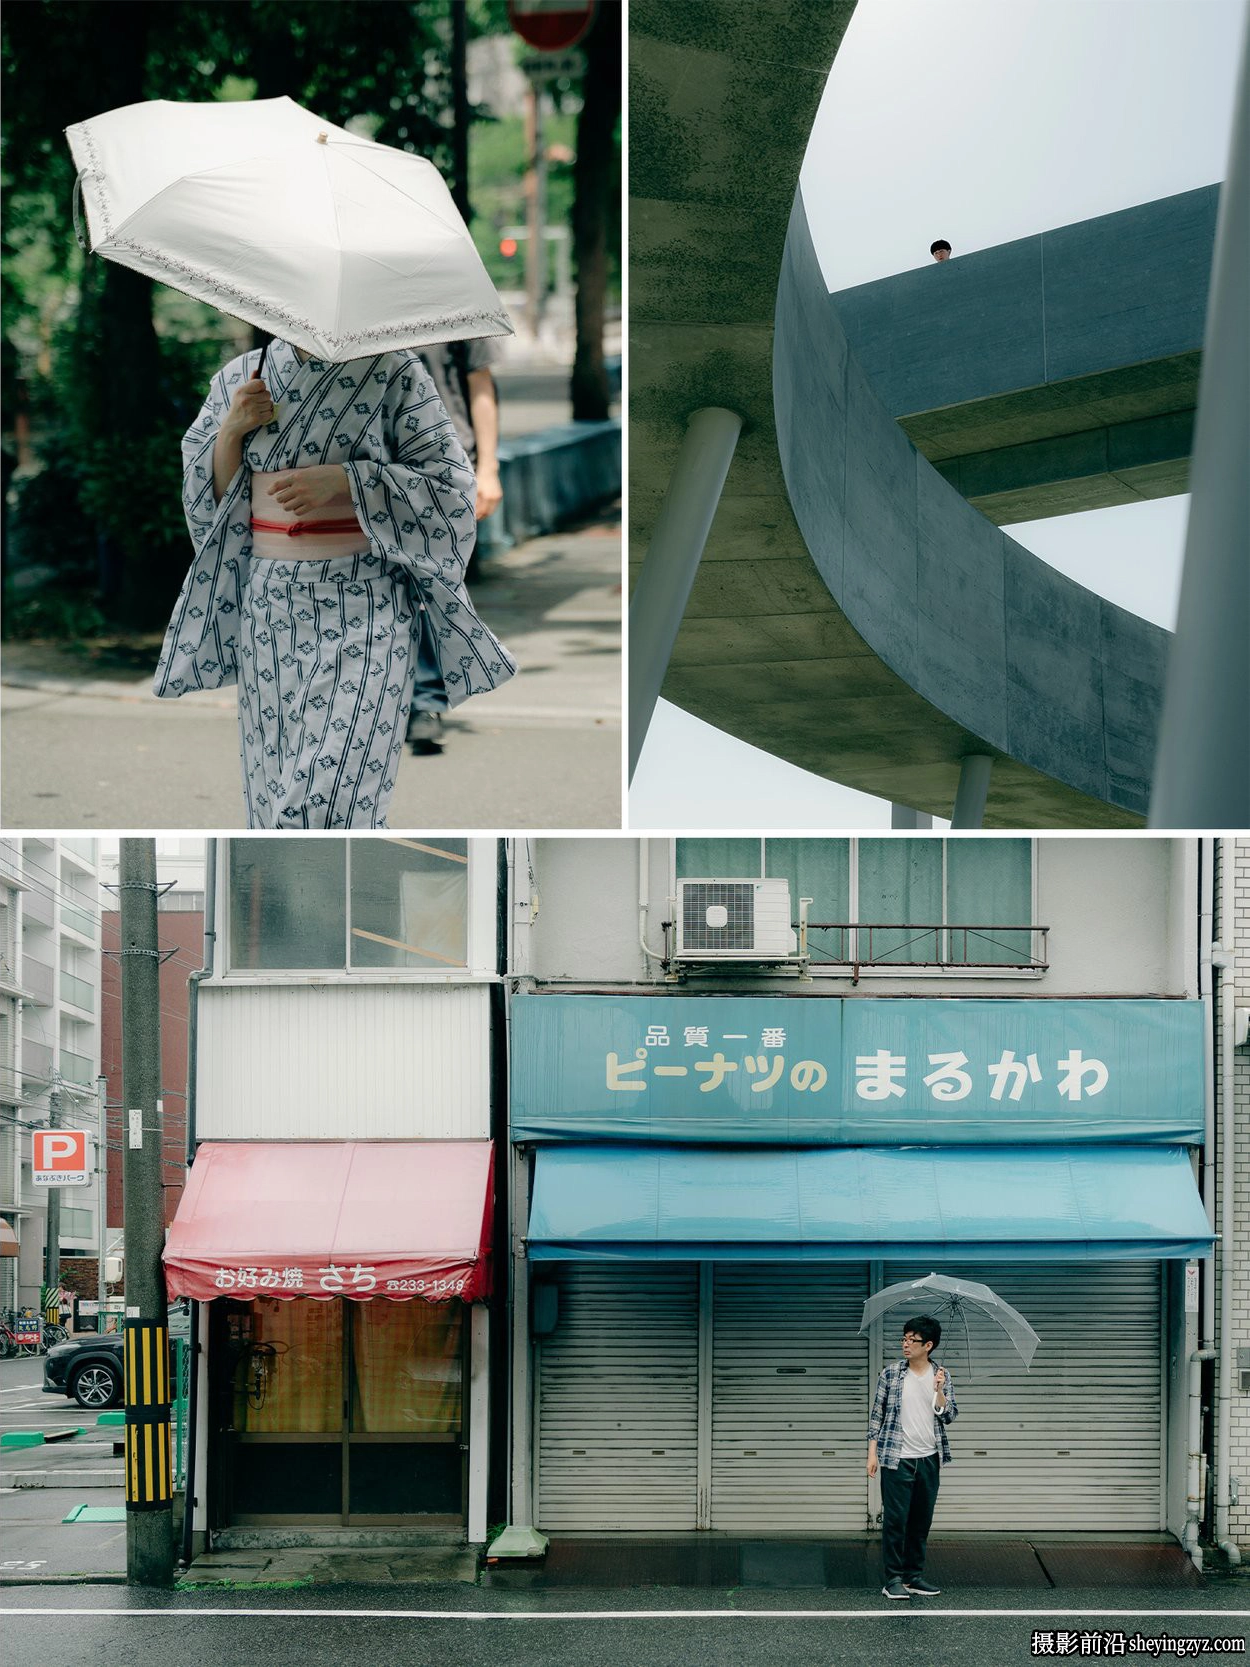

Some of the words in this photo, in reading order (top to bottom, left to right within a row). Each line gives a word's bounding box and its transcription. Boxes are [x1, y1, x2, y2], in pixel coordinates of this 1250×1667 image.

[645, 1025, 788, 1048] 品質一番
[606, 1048, 828, 1093] ピーナツの
[855, 1049, 1110, 1102] まるかわ
[42, 1135, 78, 1170] P
[214, 1266, 304, 1289] お好み焼
[318, 1263, 378, 1292] さち
